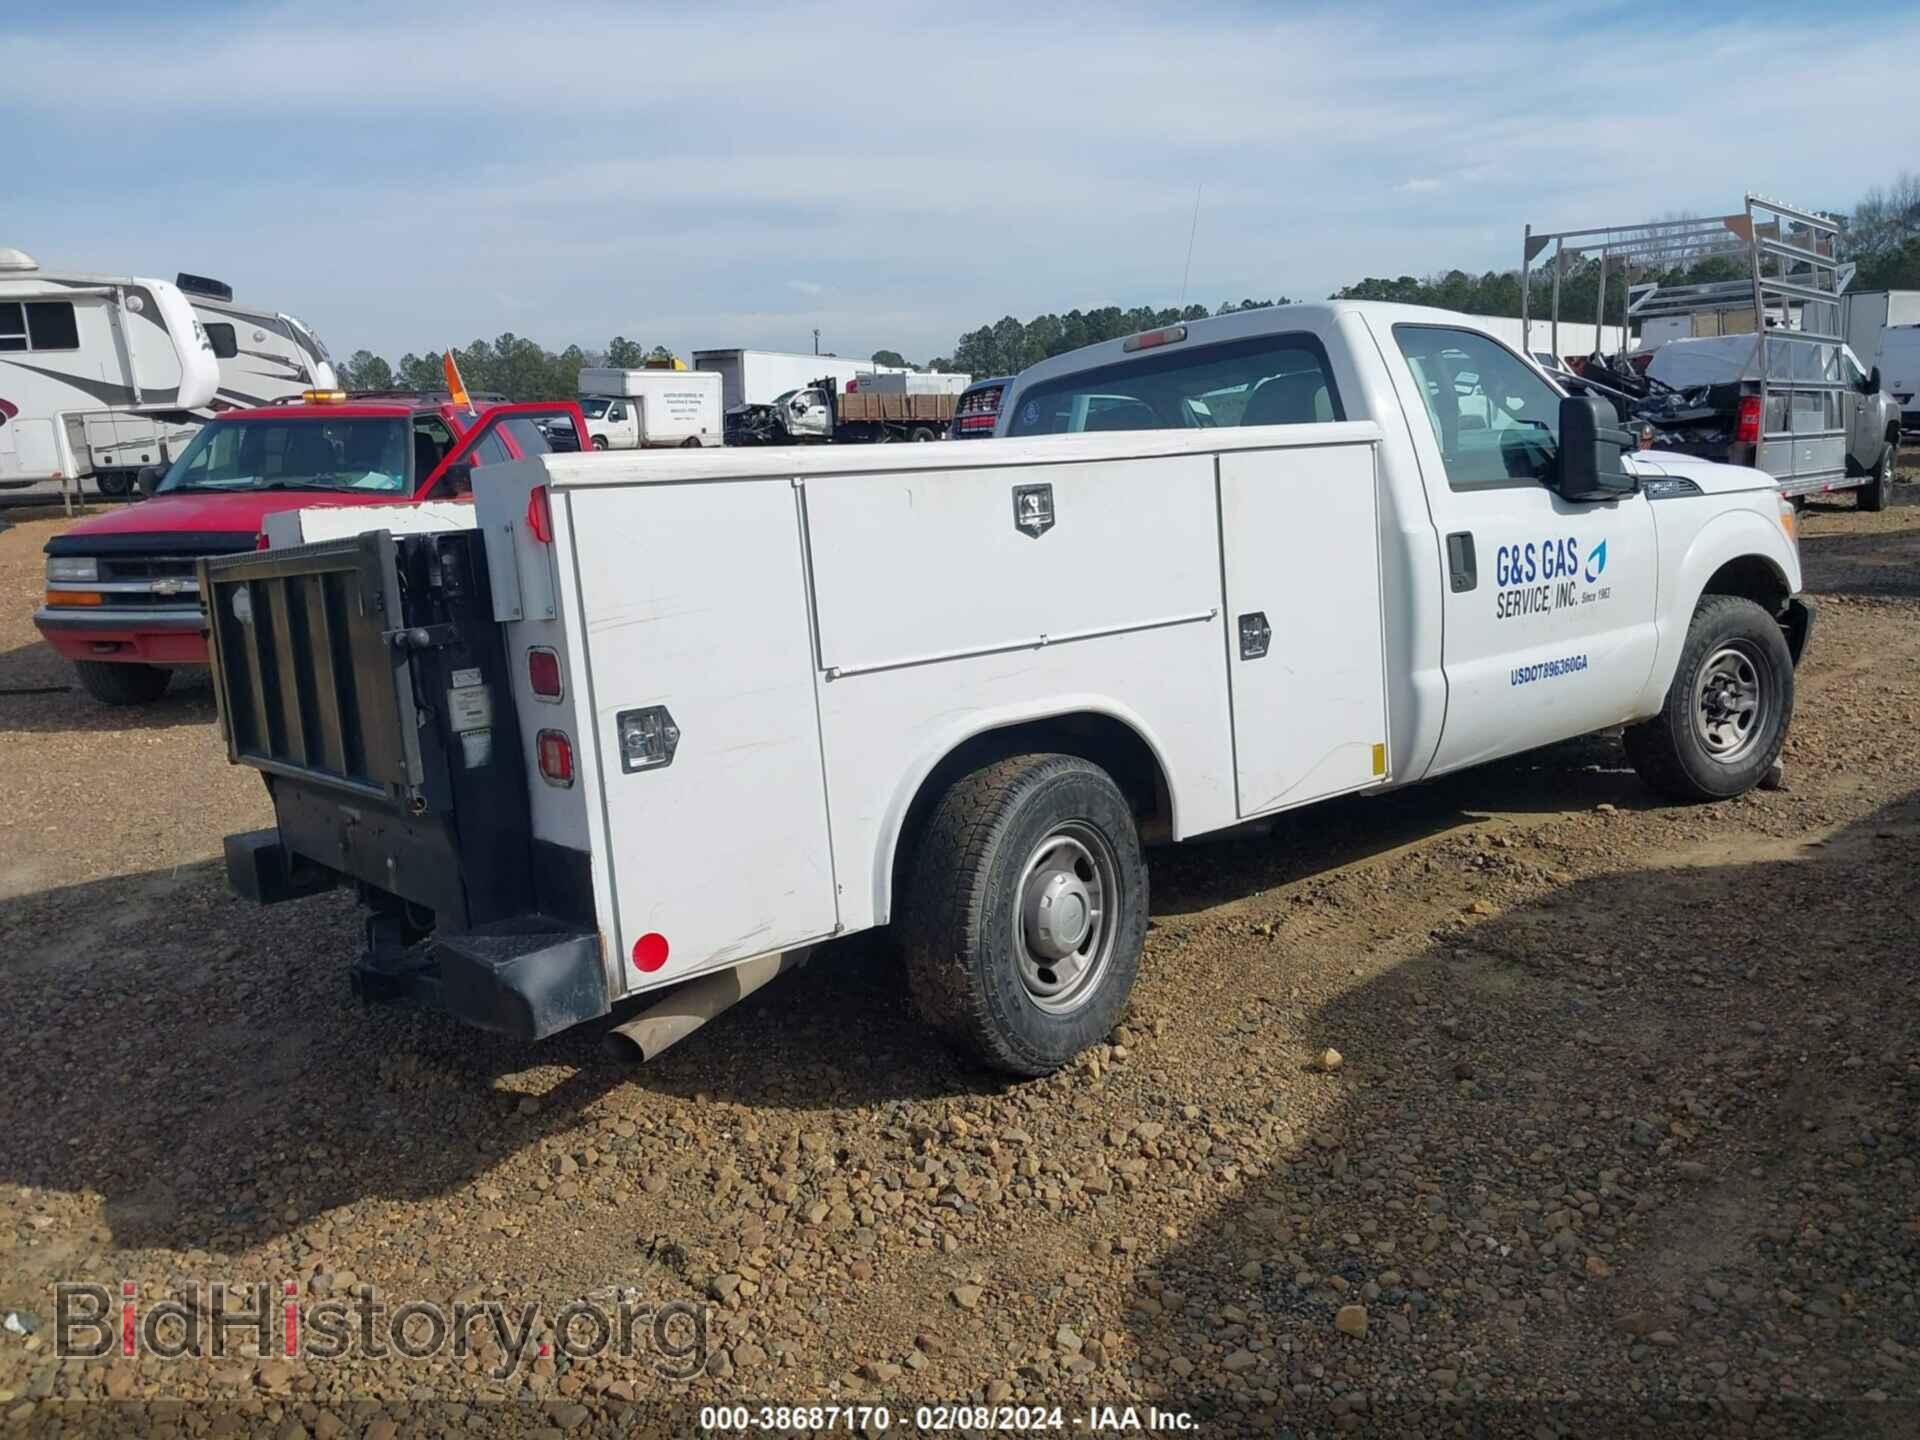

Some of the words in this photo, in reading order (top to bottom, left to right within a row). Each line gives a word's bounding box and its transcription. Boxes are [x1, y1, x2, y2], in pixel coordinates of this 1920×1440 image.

[1496, 542, 1536, 587] G&S
[1542, 536, 1578, 580] GAS
[1496, 584, 1552, 619] SERVICE,
[1555, 581, 1578, 609] INC.
